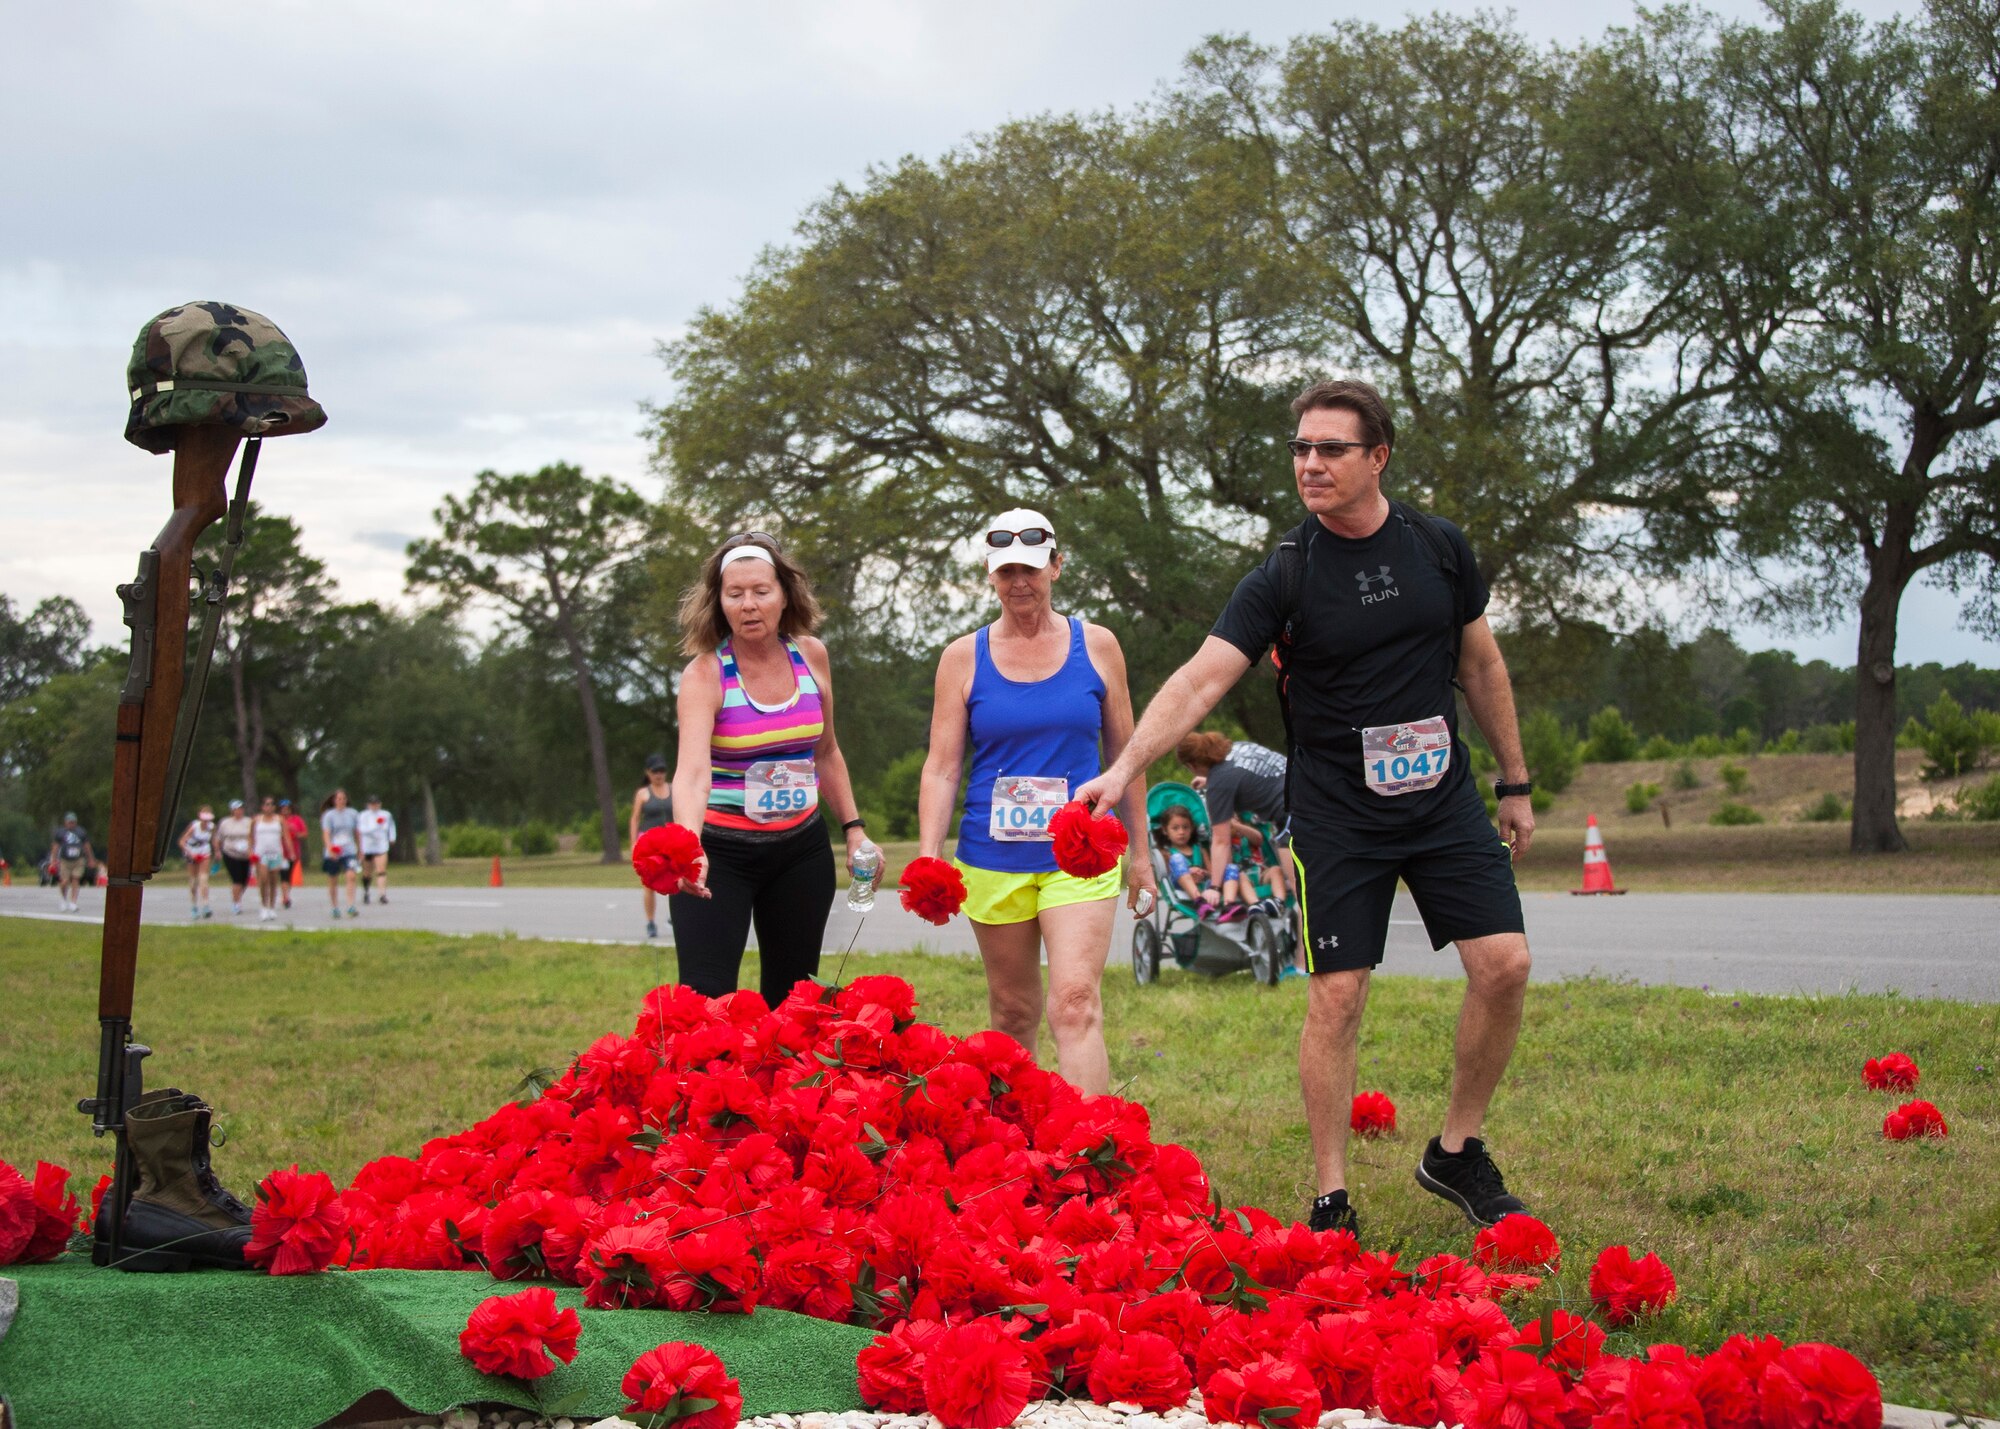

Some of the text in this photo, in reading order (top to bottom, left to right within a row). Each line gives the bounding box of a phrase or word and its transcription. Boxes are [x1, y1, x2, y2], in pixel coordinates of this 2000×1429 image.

[1361, 587, 1399, 605] RUN
[1371, 748, 1448, 783] 1047
[757, 788, 807, 811] 459
